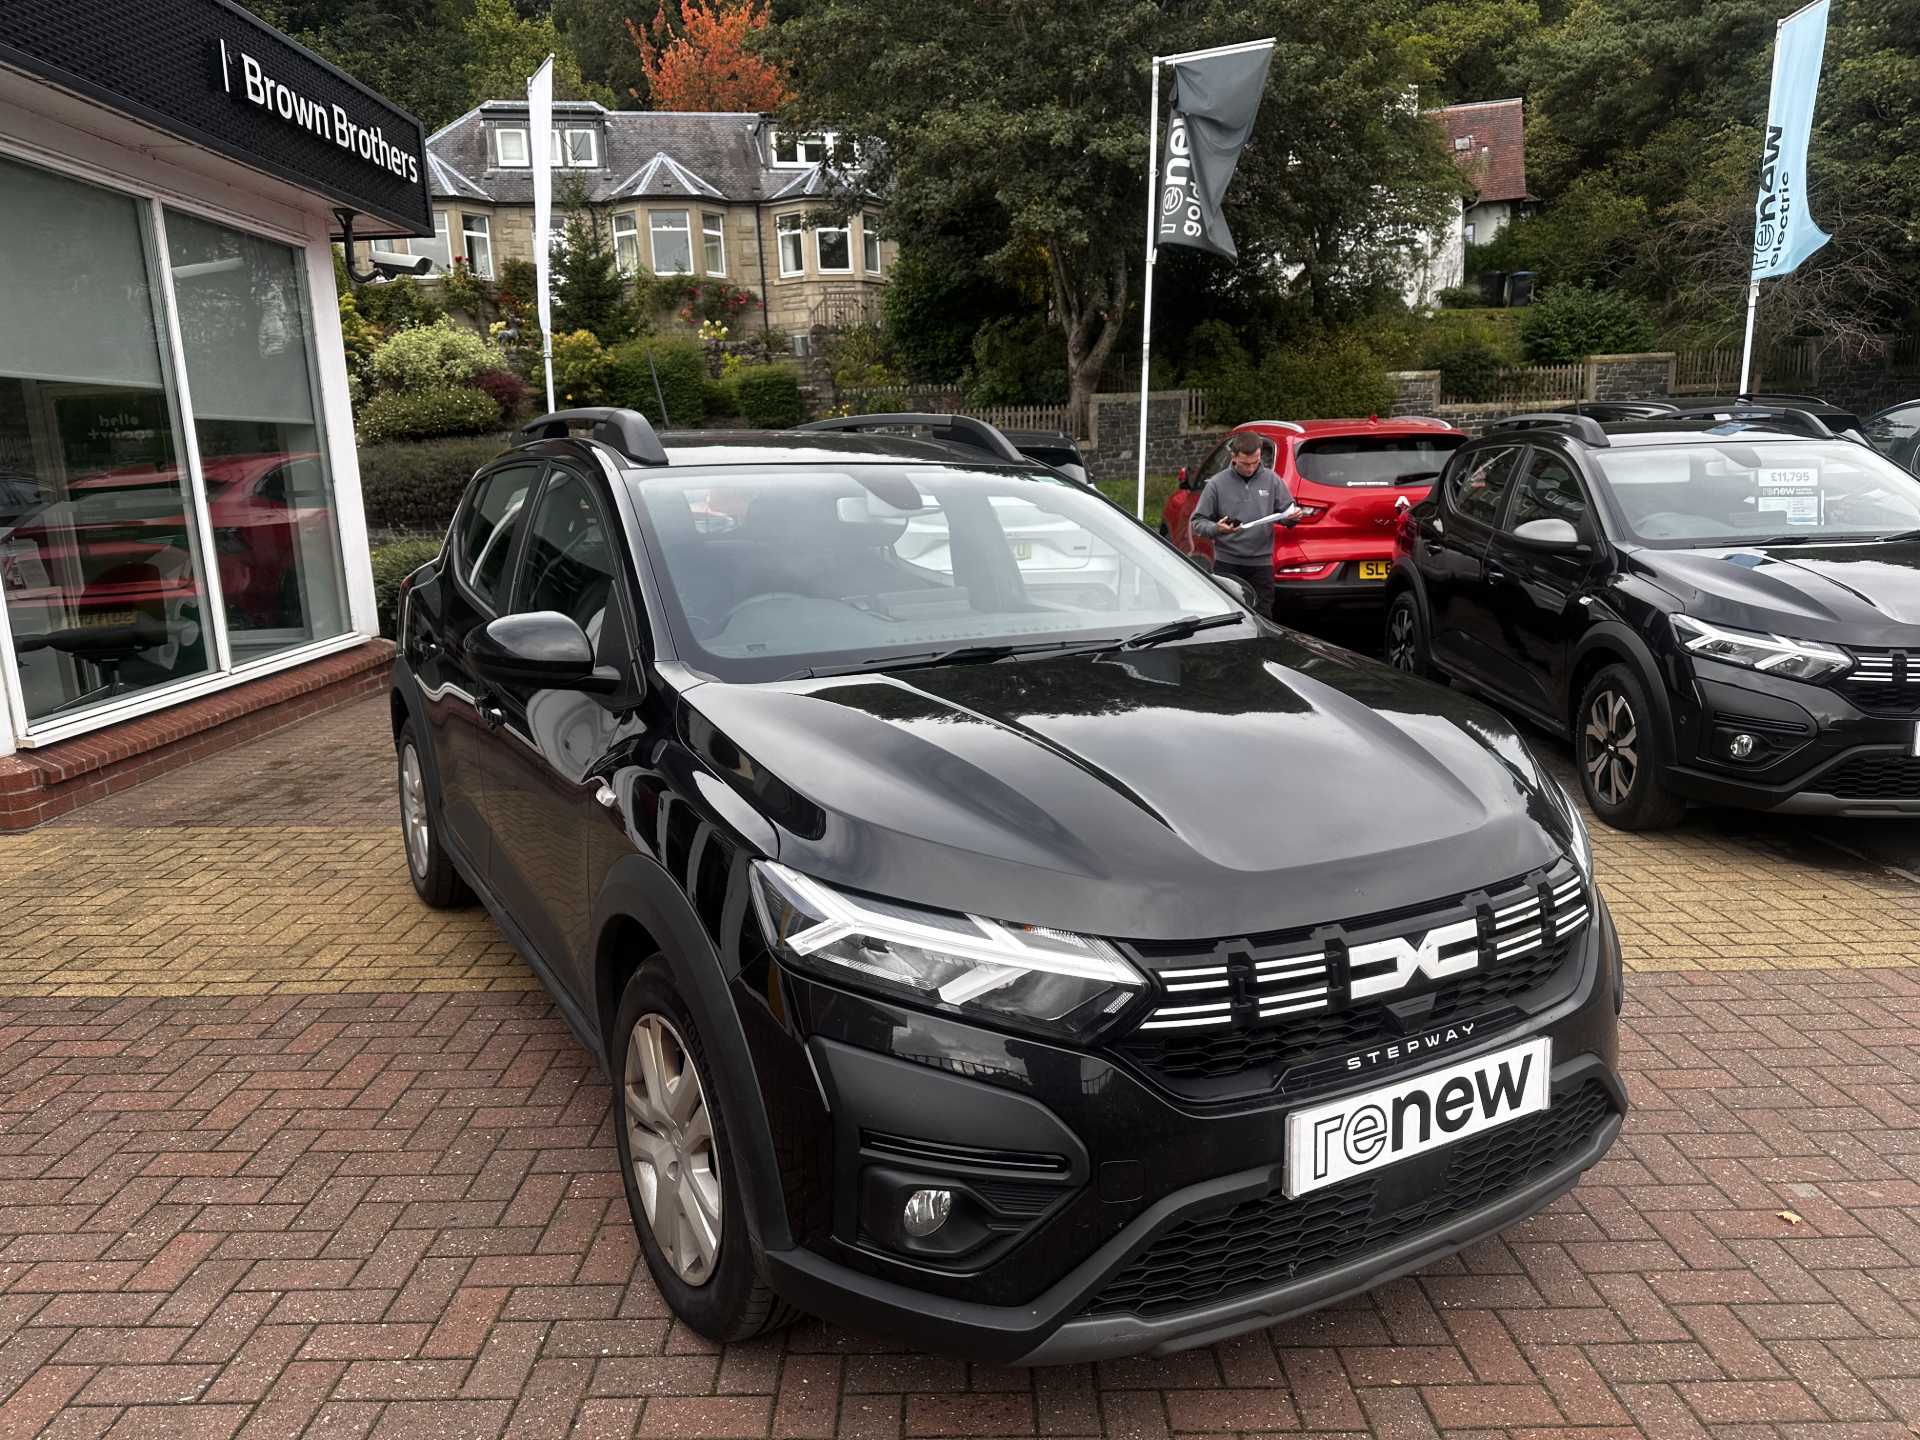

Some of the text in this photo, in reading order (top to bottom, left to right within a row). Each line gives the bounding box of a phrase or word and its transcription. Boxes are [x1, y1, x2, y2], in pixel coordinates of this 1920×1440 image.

[241, 52, 418, 184] Brown Brothers
[1752, 126, 1783, 271] renew
[1770, 171, 1790, 267] electric
[1346, 1022, 1475, 1071] STEPWAY
[1312, 1054, 1534, 1182] renew
